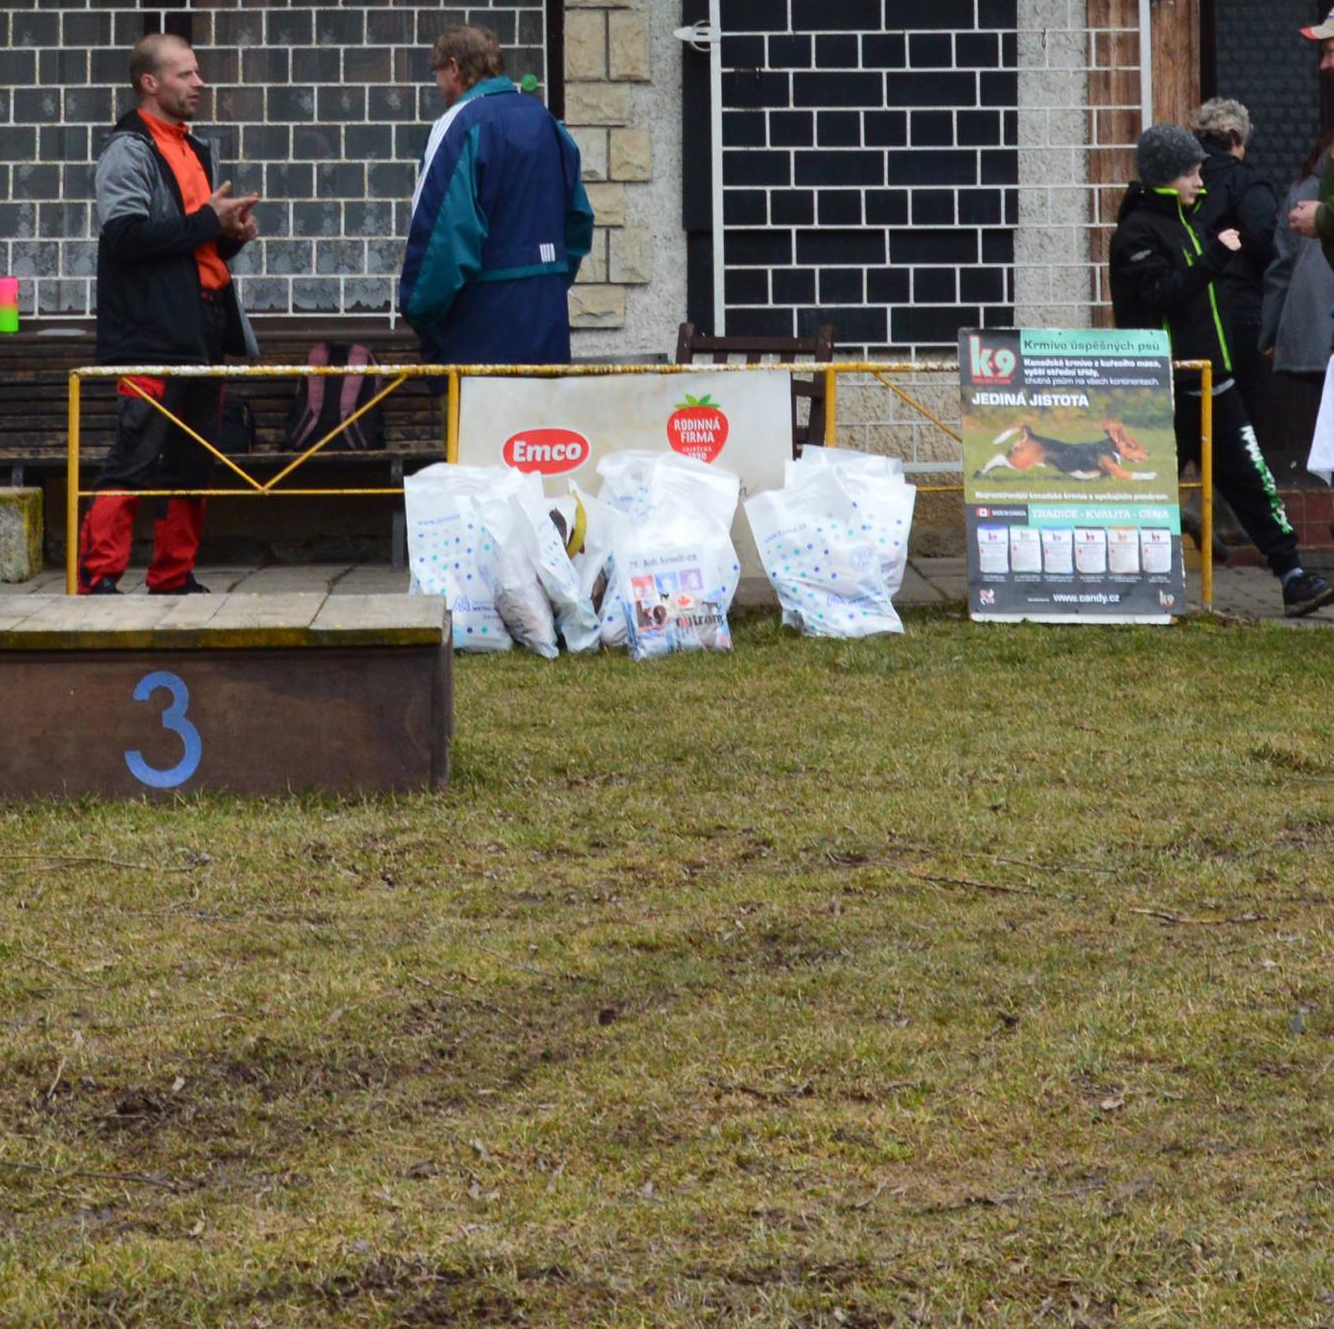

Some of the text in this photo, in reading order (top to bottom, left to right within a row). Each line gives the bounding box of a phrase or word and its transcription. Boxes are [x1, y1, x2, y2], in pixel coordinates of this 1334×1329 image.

[1024, 338, 1160, 353] Krmivo úspěšných psů
[971, 391, 1090, 408] JEDINÁ JISTOTA
[673, 415, 721, 431] RODINNÁ
[680, 430, 715, 444] FIRMA
[512, 439, 582, 462] Emco
[1033, 508, 1170, 519] TRADICE KVALITA CENA
[1052, 592, 1120, 605] www.candy.cz
[124, 670, 203, 789] 3
